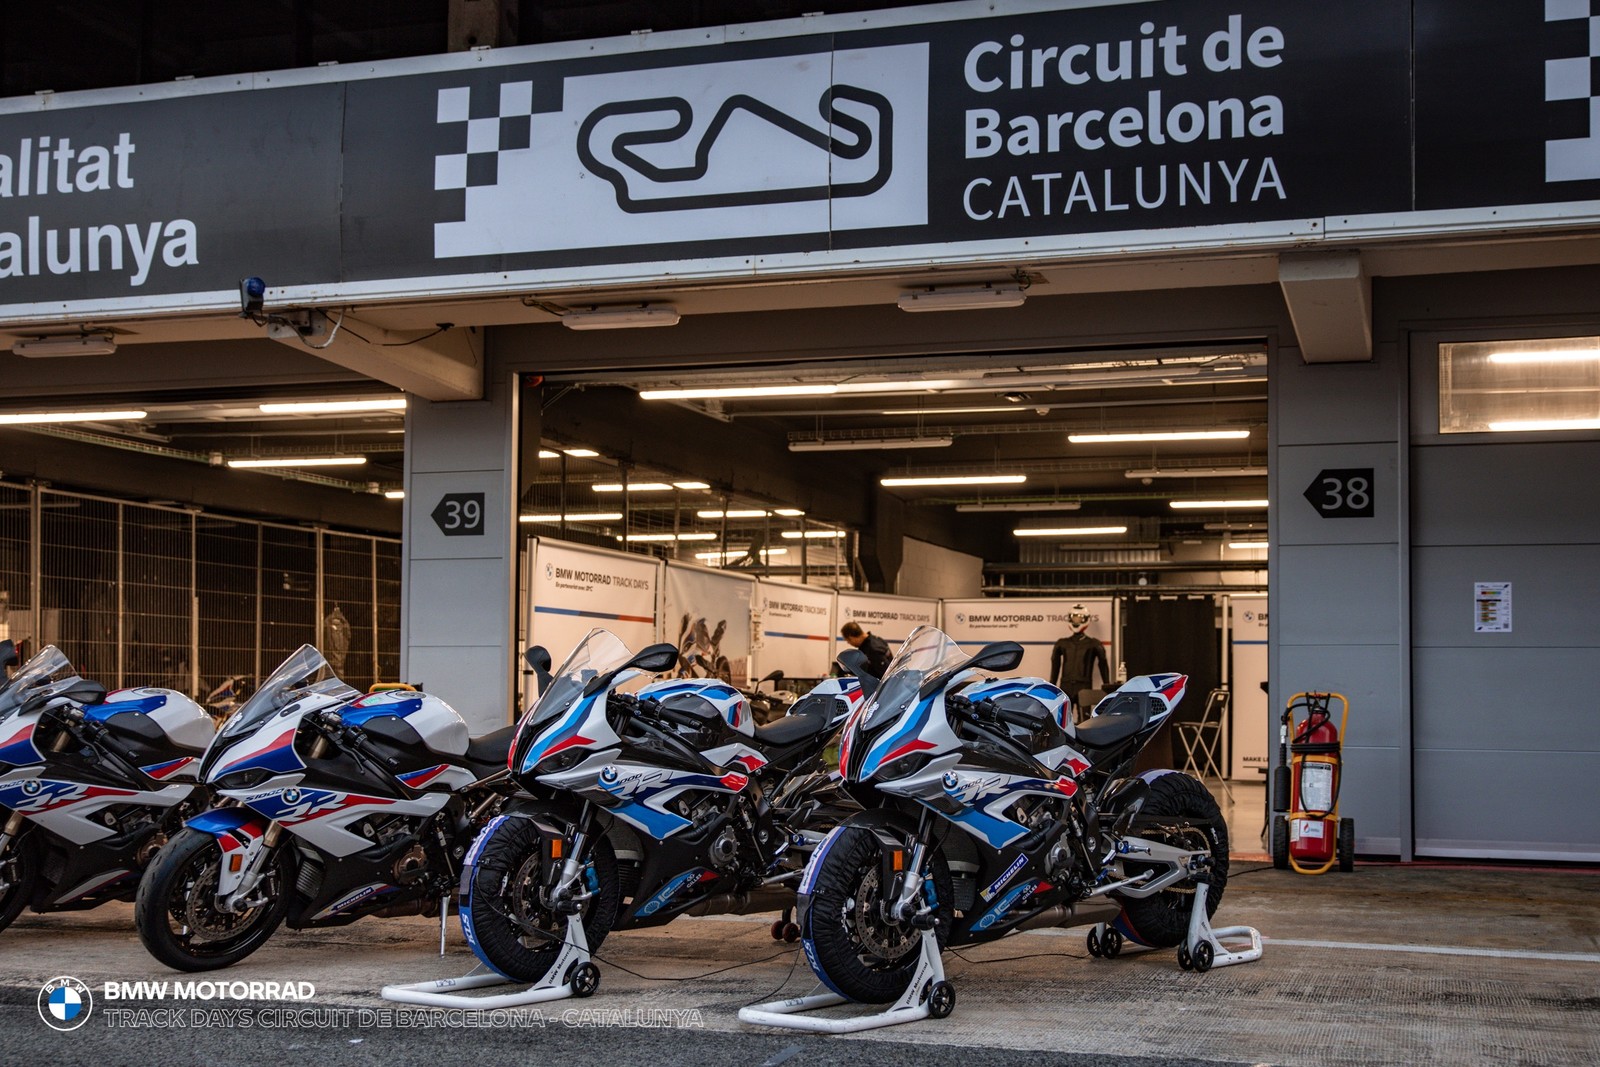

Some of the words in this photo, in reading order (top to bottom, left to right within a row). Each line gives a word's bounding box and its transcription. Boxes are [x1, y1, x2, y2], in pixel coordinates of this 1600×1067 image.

[964, 21, 1187, 93] Circuit
[1202, 14, 1285, 73] de
[965, 90, 1284, 159] Barcelona
[963, 157, 1287, 221] CATALUNYA
[1322, 477, 1369, 510] 38
[445, 500, 480, 529] 39
[555, 568, 573, 580] BMW
[574, 570, 611, 585] MOTORRAD
[612, 576, 633, 588] TRACK
[633, 579, 649, 590] DAYS
[868, 611, 898, 620] MOTORRAD
[245, 788, 284, 800] S1000
[994, 857, 1024, 890] MICHELIN
[337, 888, 371, 909] MICHELIN
